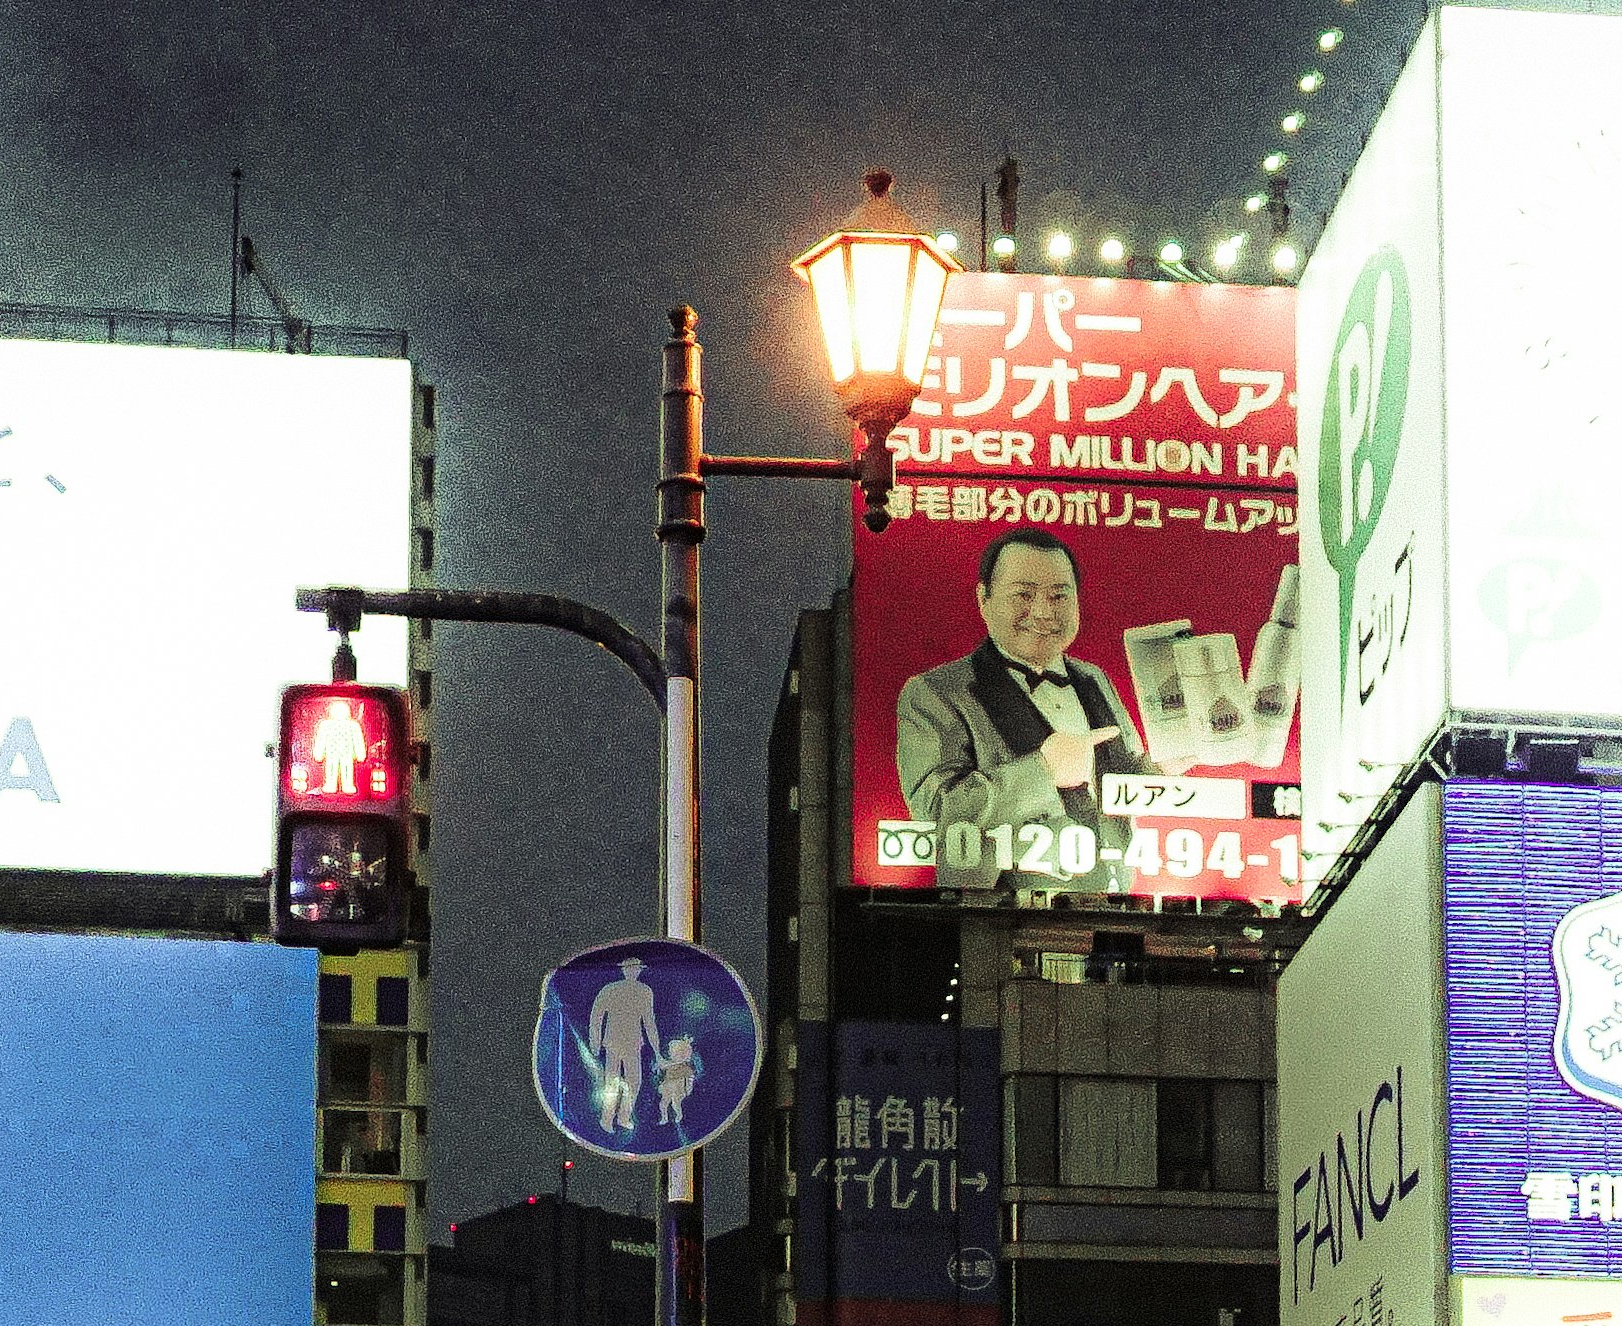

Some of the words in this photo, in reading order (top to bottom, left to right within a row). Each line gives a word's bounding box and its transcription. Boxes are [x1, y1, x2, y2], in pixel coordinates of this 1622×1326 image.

[933, 288, 1142, 353] ーパー
[911, 356, 1298, 430] リオンヘア
[885, 427, 1035, 468] SUPER
[1049, 434, 1223, 477] MILLION
[1112, 782, 1197, 808] ルアン
[944, 820, 1300, 884] 0120-494-1
[835, 1094, 965, 1150] 龍角散
[1293, 1065, 1420, 1306] FANCL
